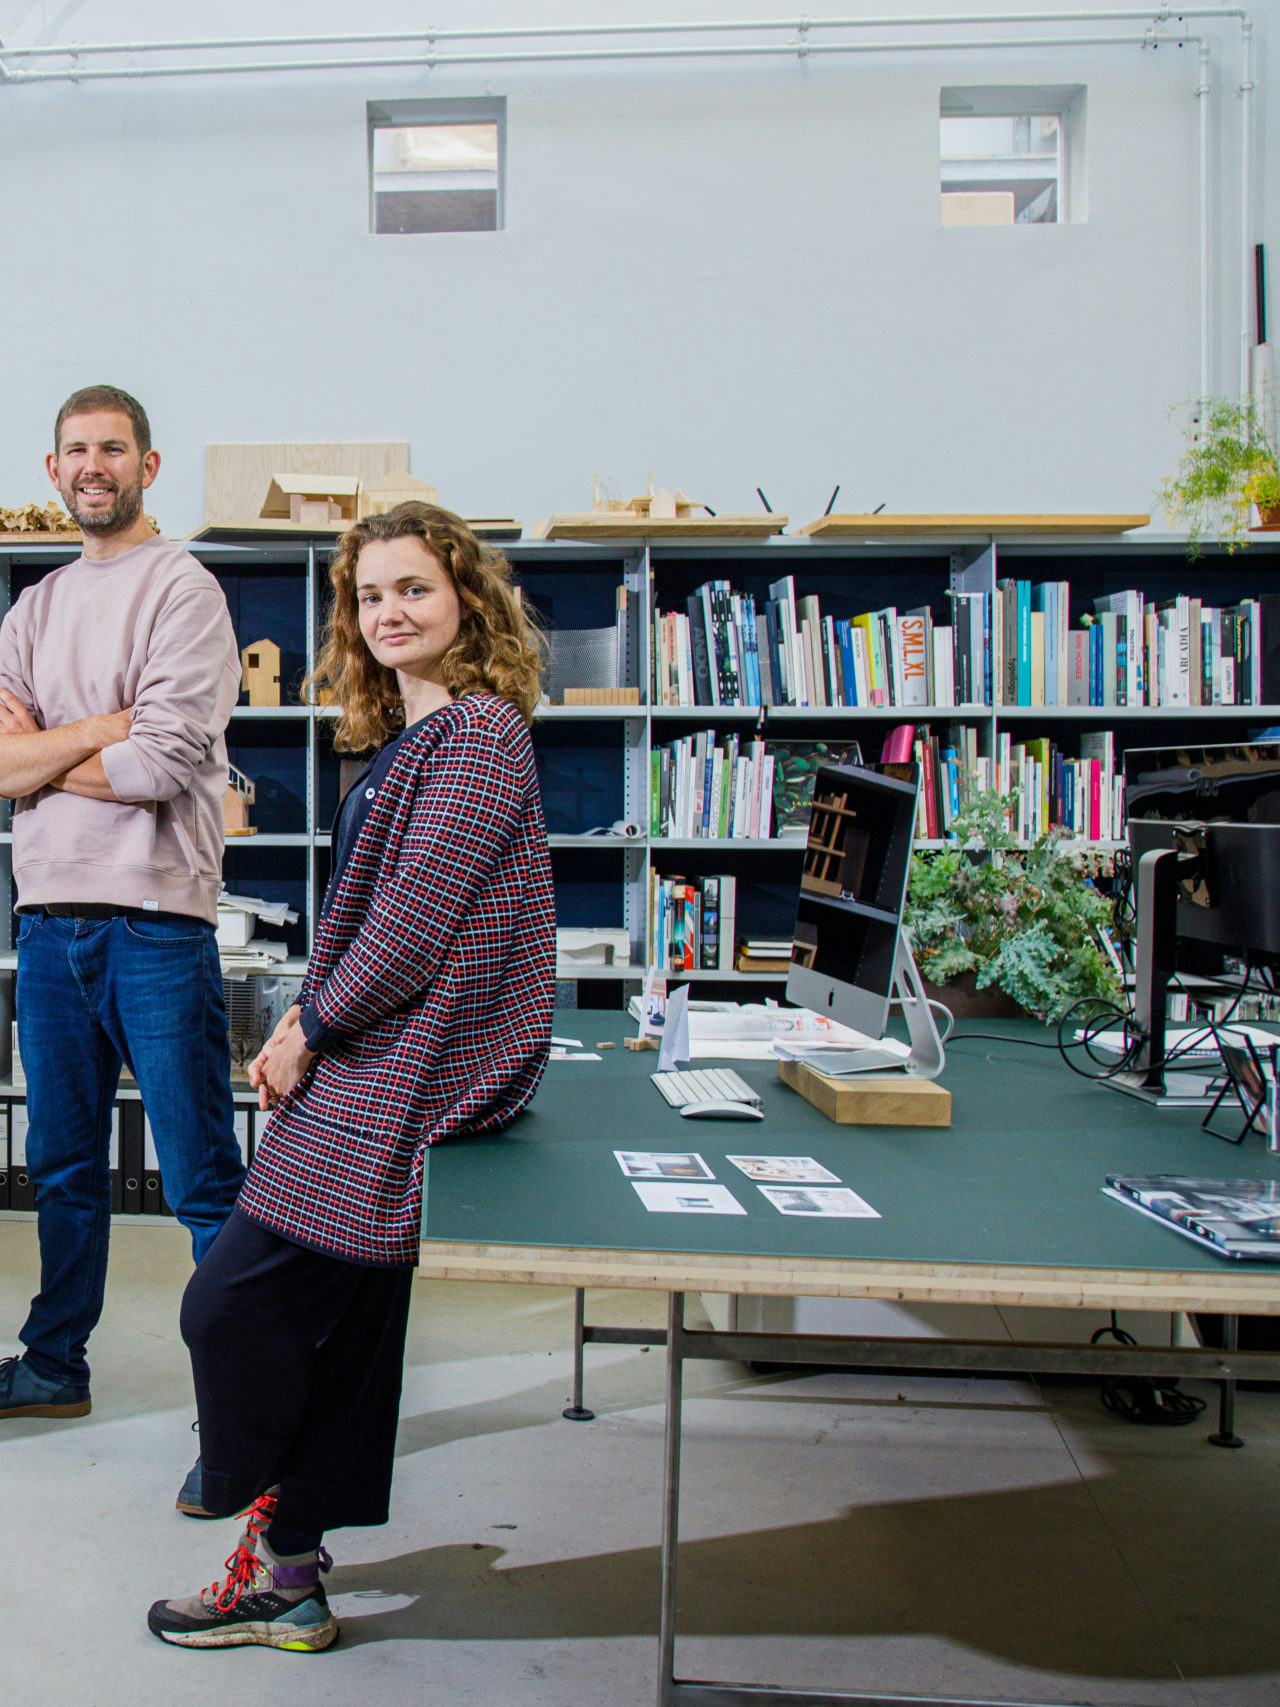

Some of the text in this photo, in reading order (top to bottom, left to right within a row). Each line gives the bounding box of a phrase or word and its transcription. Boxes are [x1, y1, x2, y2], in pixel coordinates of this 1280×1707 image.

[692, 626, 709, 679] ANDO
[1179, 626, 1189, 674] ARCADIA
[1007, 657, 1017, 695] typology
